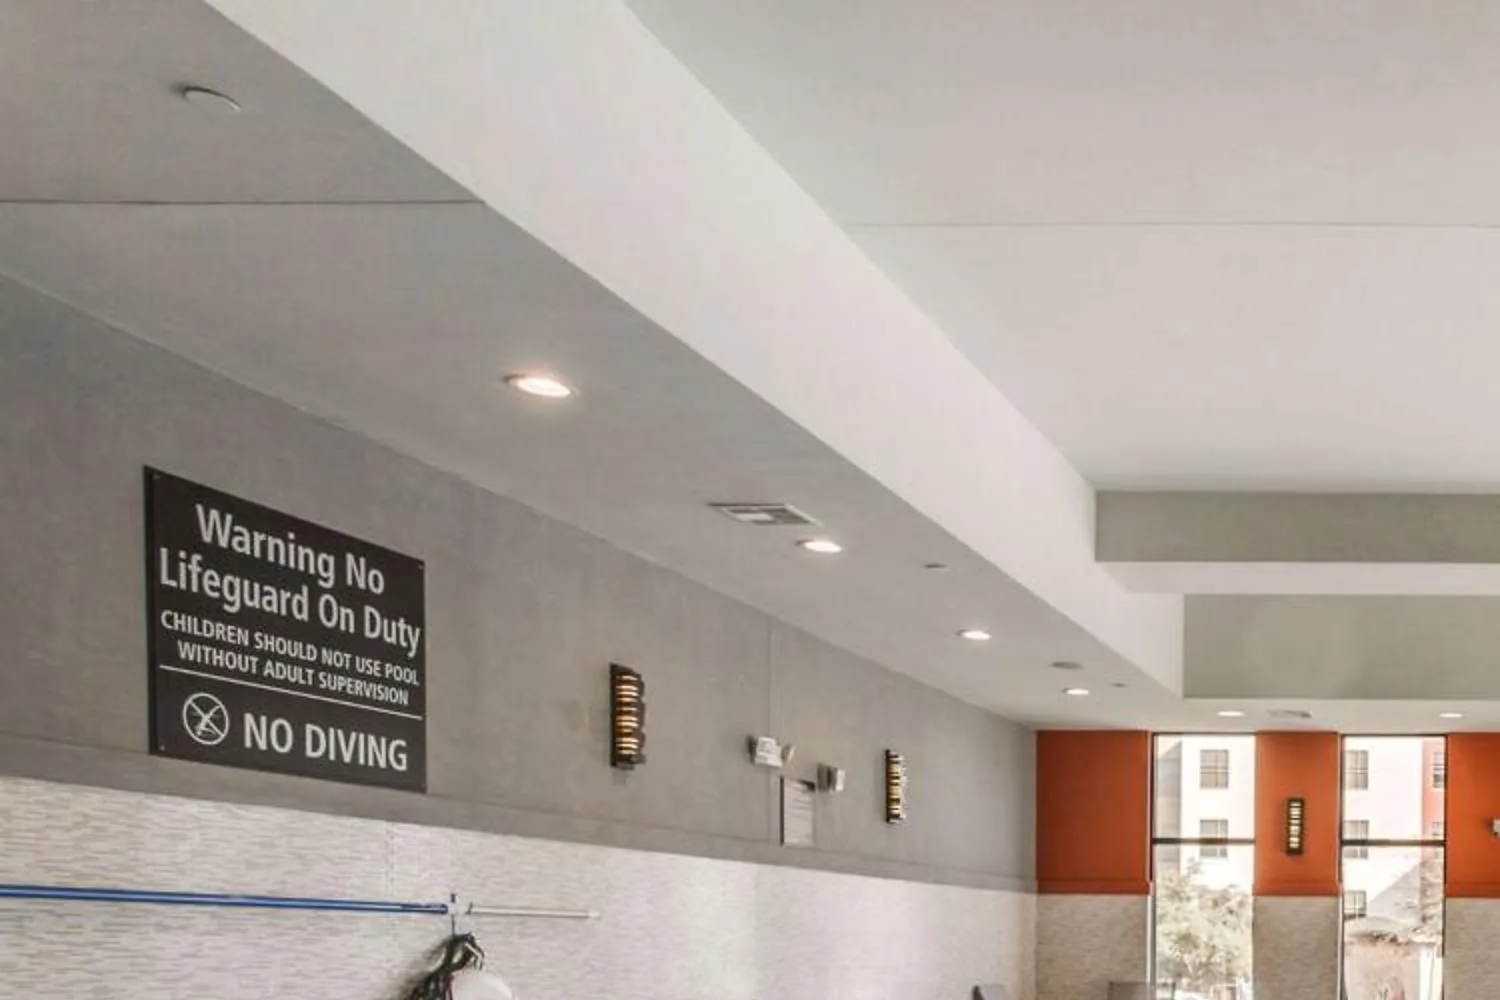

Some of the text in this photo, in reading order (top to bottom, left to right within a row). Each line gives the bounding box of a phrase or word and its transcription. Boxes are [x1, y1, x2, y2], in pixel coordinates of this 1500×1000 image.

[195, 503, 385, 595] Warning No
[159, 547, 422, 657] Lifeguard On Duty
[161, 609, 420, 686] CHILDREN SHOULD NOT USE POOL
[177, 640, 409, 706] WITHOUT ADULT SUPERVISION
[243, 713, 408, 772] NO DIVING
